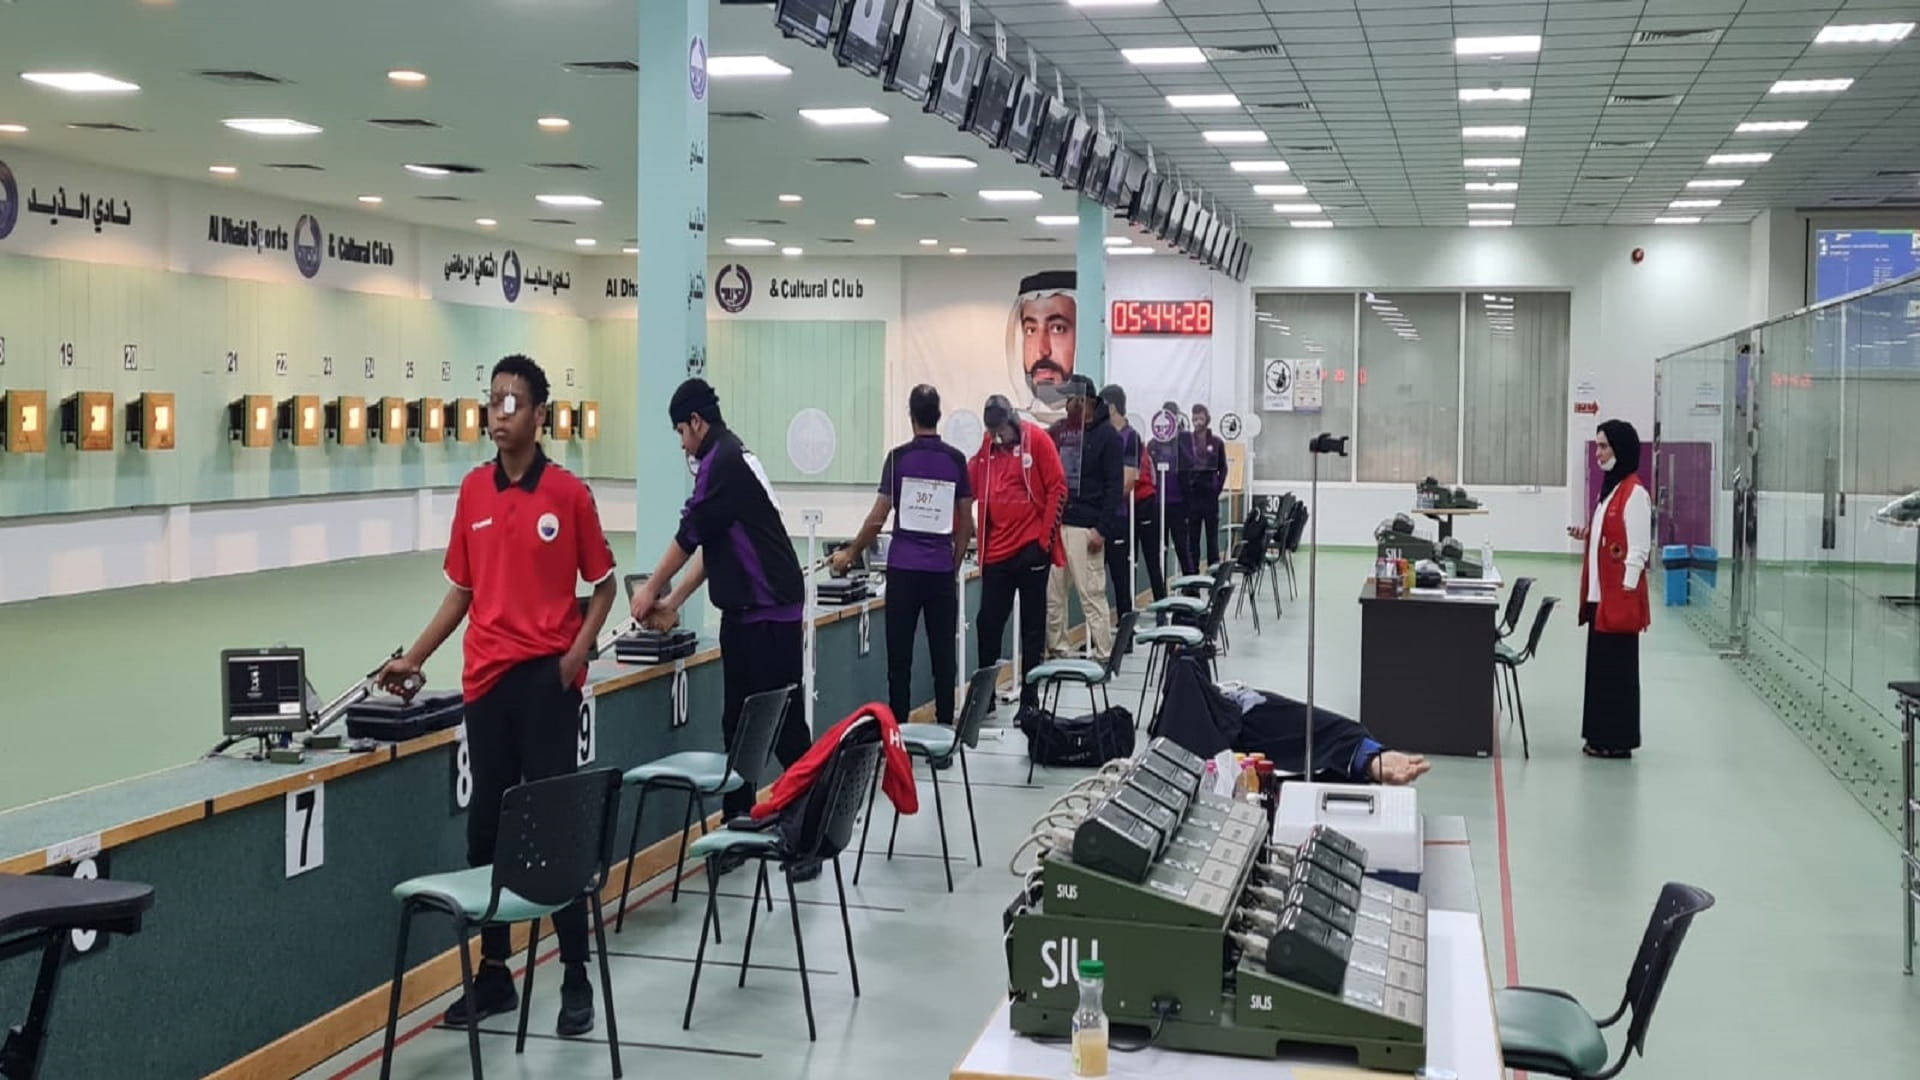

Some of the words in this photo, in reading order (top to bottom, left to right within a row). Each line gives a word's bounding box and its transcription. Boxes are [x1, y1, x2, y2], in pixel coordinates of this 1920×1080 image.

[28, 186, 91, 225] الذيد
[93, 197, 131, 233] نادي
[208, 214, 219, 242] Al
[221, 217, 248, 246] Dhaid
[328, 233, 335, 258] &
[338, 236, 370, 264] Cultural
[372, 241, 394, 266] Club
[606, 278, 617, 298] Al
[769, 278, 779, 298] &
[781, 278, 828, 300] Cultural
[832, 279, 864, 299] Club
[1113, 302, 1211, 331] 05:44:28
[60, 343, 73, 366] 19
[125, 345, 137, 370] 20
[227, 351, 238, 372] 21
[1266, 495, 1280, 512] 30
[858, 611, 870, 655] 12
[671, 669, 689, 726] 10
[578, 702, 592, 762] 9
[456, 740, 473, 808] 8
[295, 790, 317, 867] 7
[1056, 884, 1078, 899] SIUS
[1250, 994, 1272, 1010] SIUS
